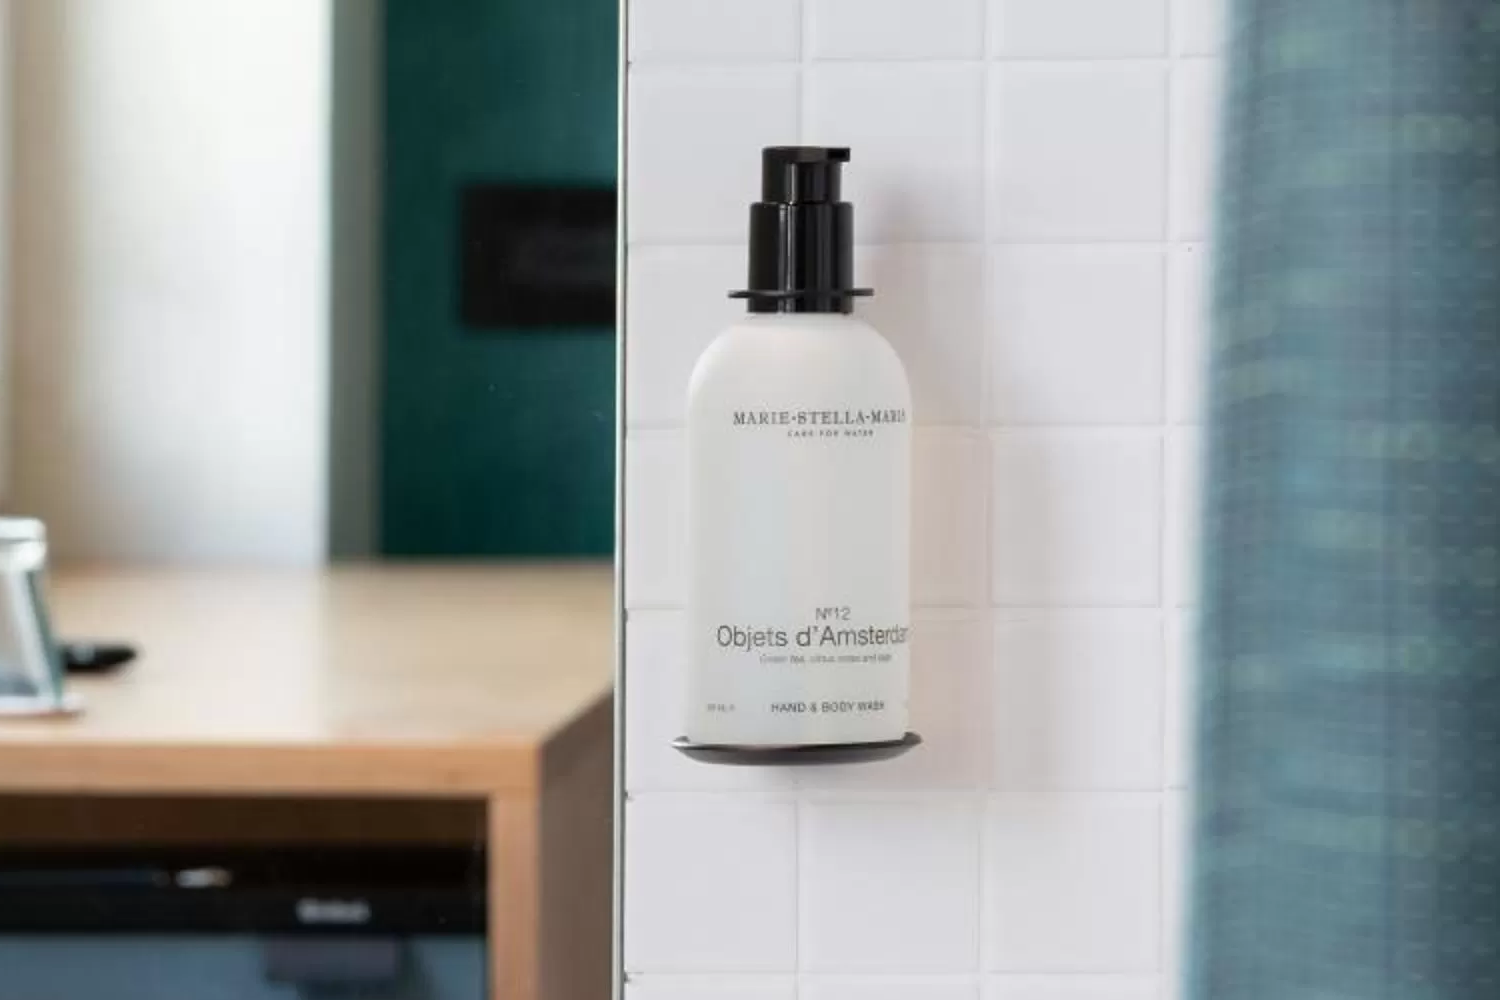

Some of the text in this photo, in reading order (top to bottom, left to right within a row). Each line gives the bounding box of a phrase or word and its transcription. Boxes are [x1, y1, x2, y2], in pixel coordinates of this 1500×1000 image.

[717, 625, 788, 651] Objets
[771, 702, 806, 713] HAND
[810, 702, 817, 712] &
[822, 701, 853, 712] BODY
